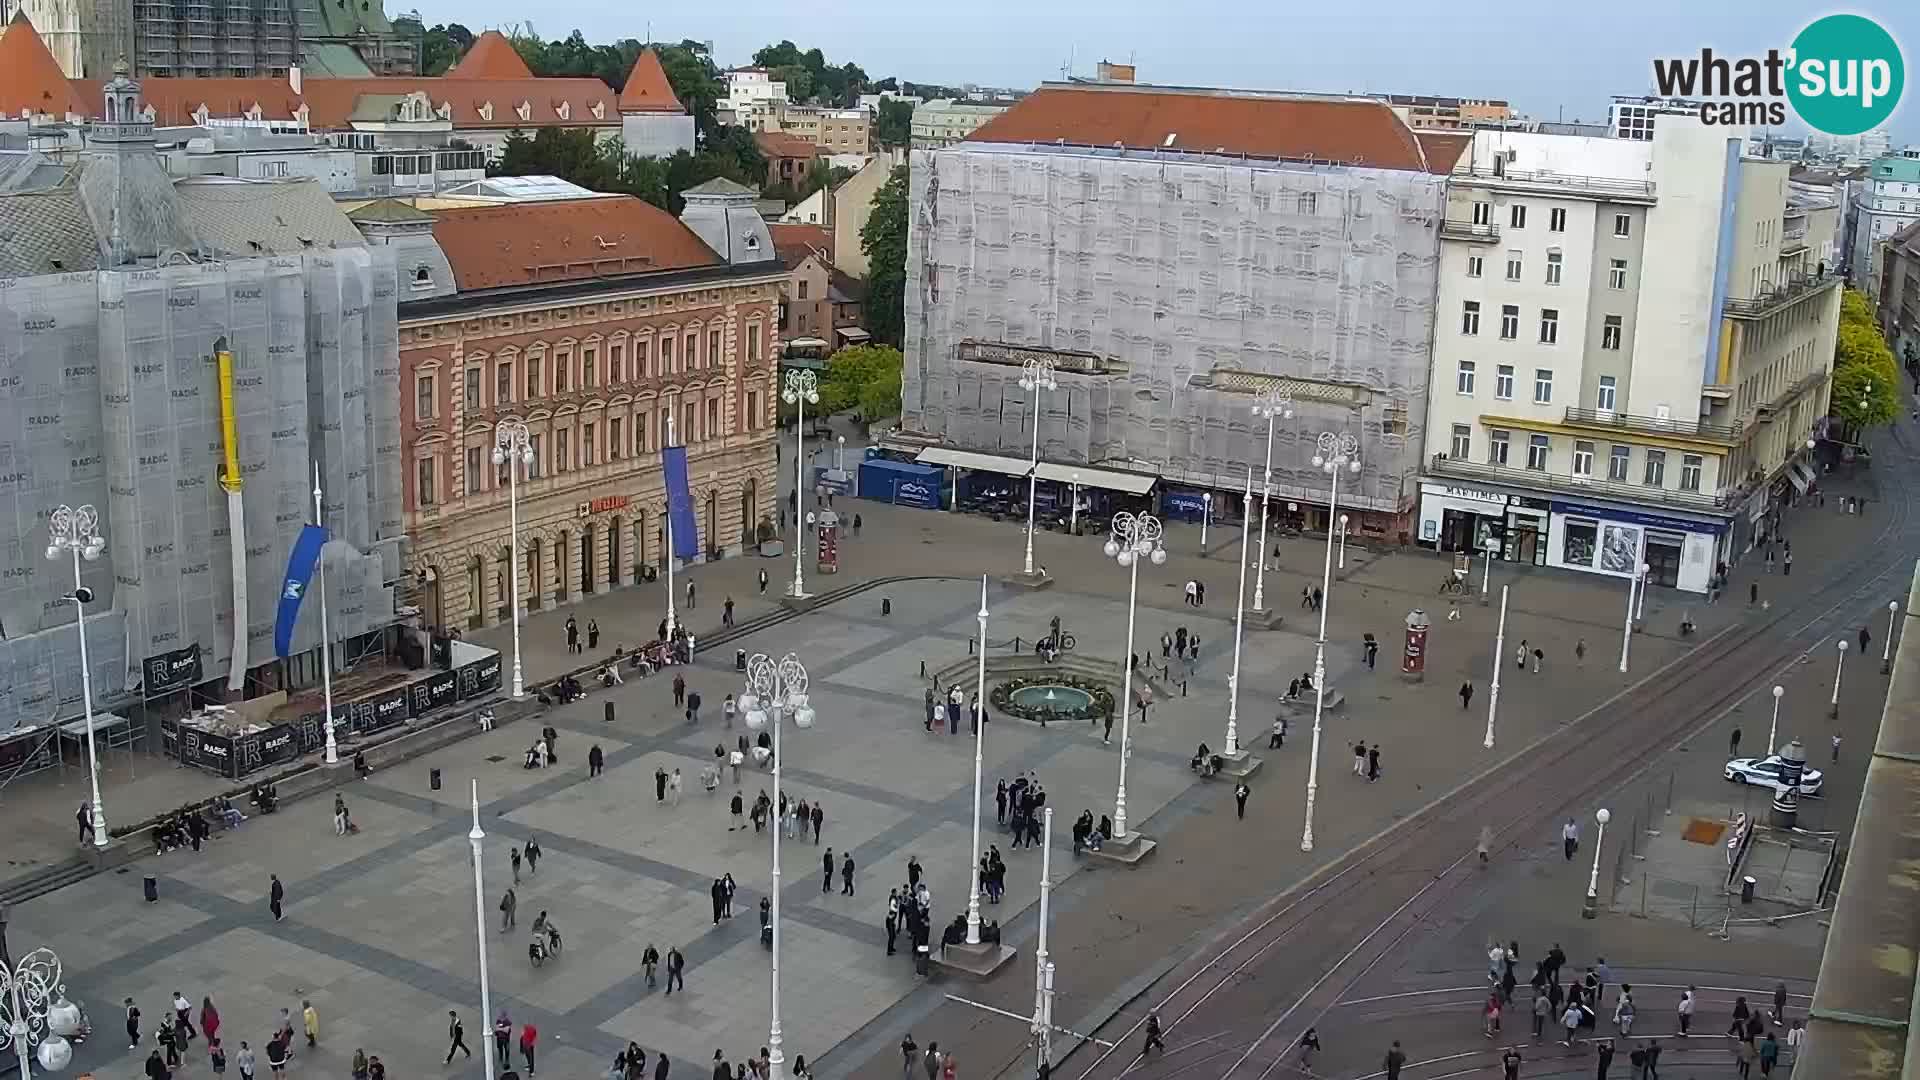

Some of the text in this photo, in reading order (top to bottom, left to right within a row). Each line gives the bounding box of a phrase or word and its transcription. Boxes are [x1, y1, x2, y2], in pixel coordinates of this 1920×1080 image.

[24, 316, 57, 330] RADIĆ
[65, 364, 97, 377] RADIĆ
[172, 385, 200, 398] RADIĆ
[28, 413, 61, 425] RADIĆ
[71, 453, 103, 468] RADIĆ
[139, 451, 169, 465] RADIĆ
[433, 679, 454, 695] RADIĆ
[379, 697, 403, 713] RADIĆ
[265, 732, 290, 749] RADIĆ
[203, 743, 227, 757] RADIĆ
